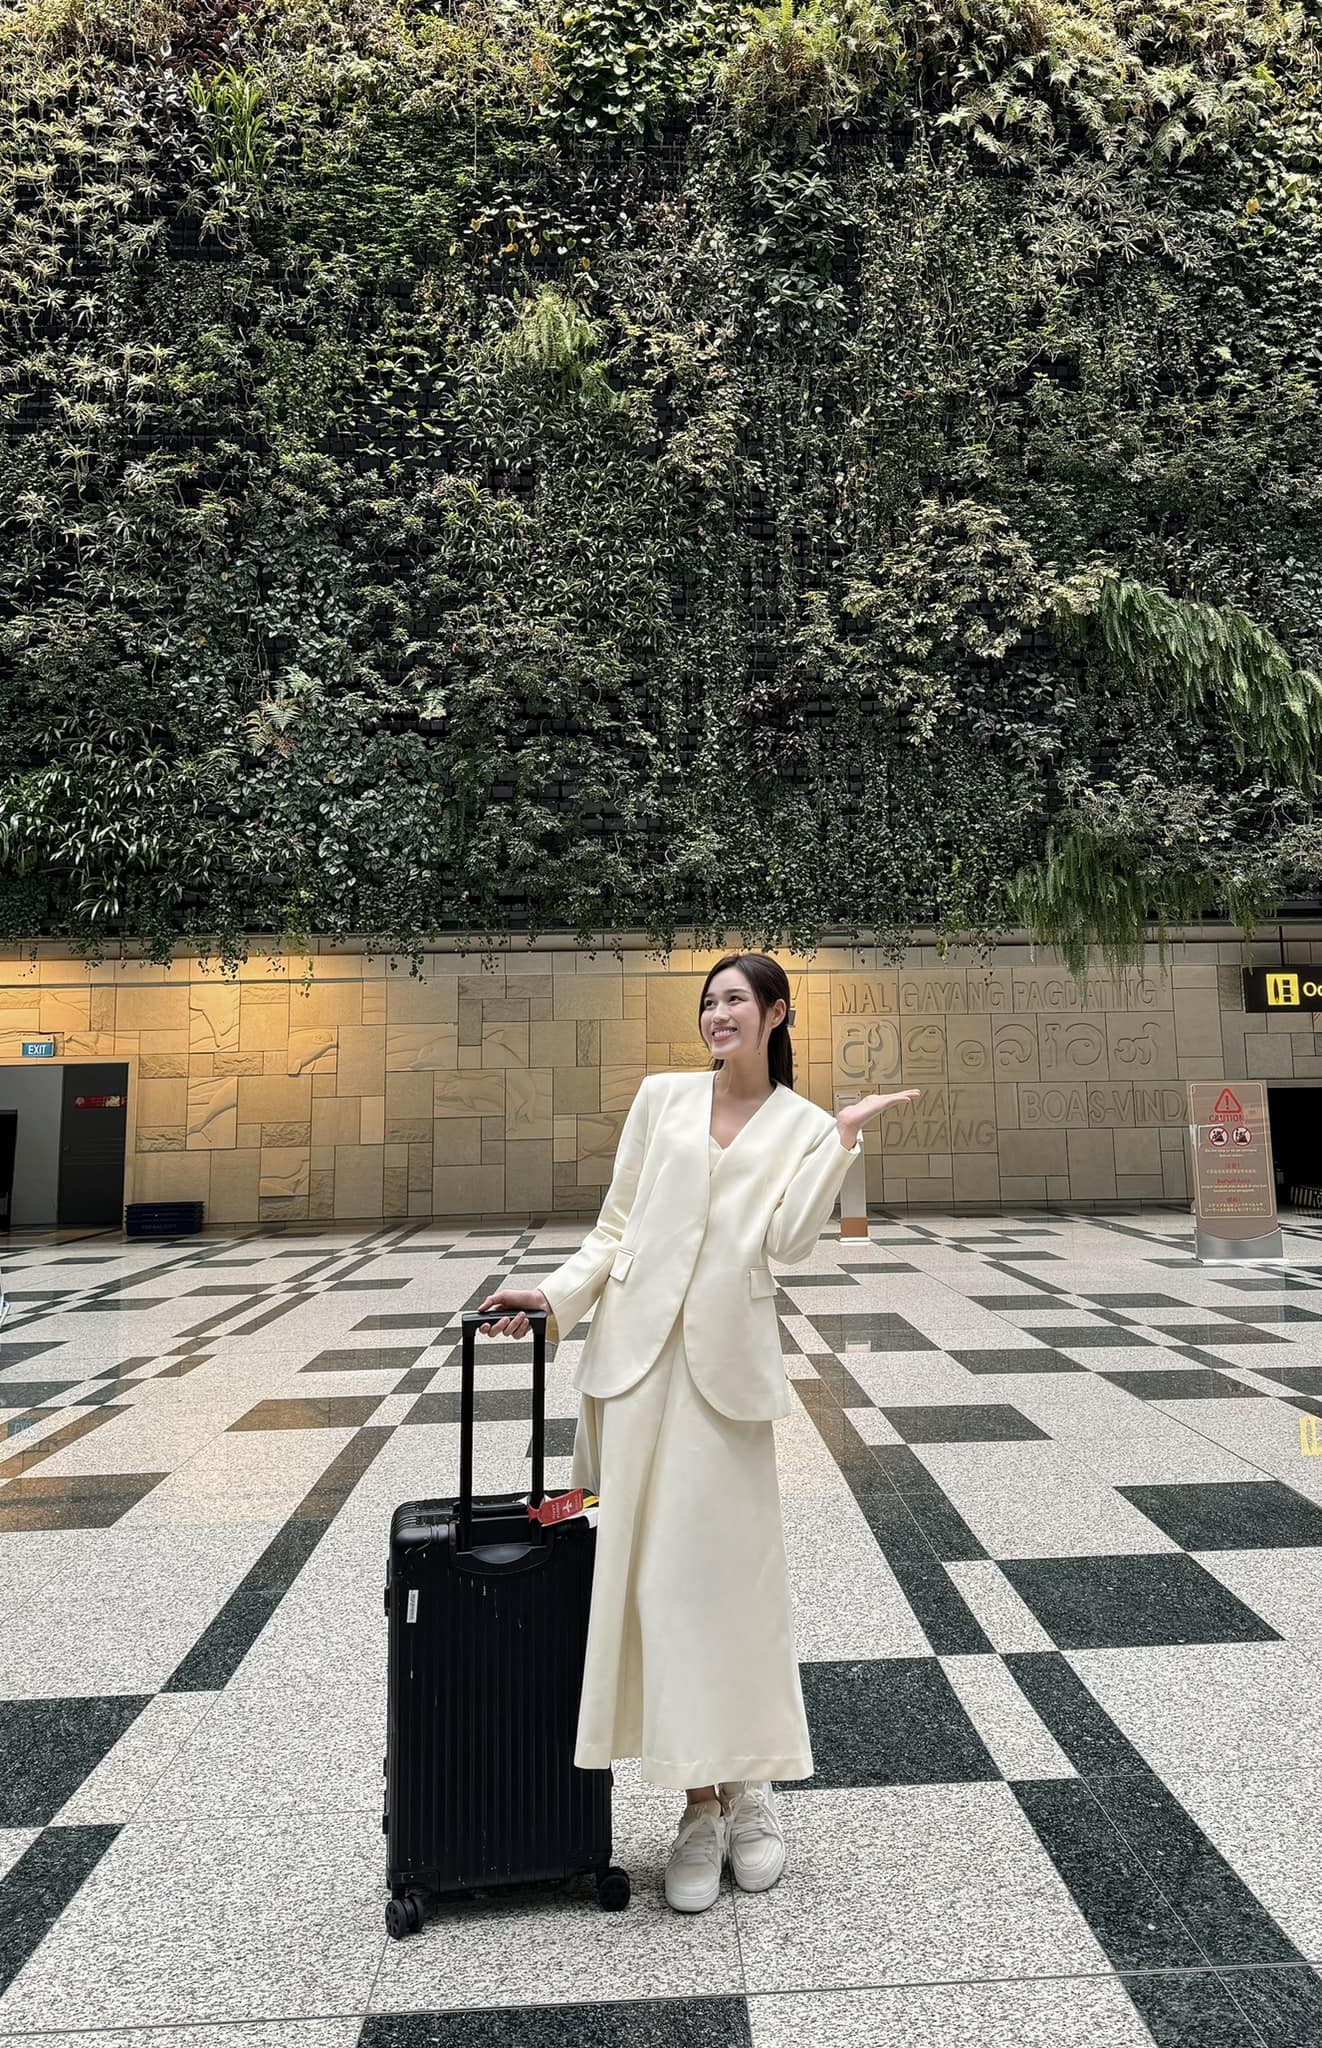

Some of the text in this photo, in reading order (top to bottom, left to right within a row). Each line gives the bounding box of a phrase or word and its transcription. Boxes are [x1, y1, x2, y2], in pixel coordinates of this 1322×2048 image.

[838, 981, 1005, 1014] MALIGAYANG
[1013, 979, 1158, 1011] PAGDATING
[28, 1044, 47, 1055] EXIT
[1022, 1089, 1190, 1123] BOAS-VIND
[883, 1119, 996, 1149] DATANG
